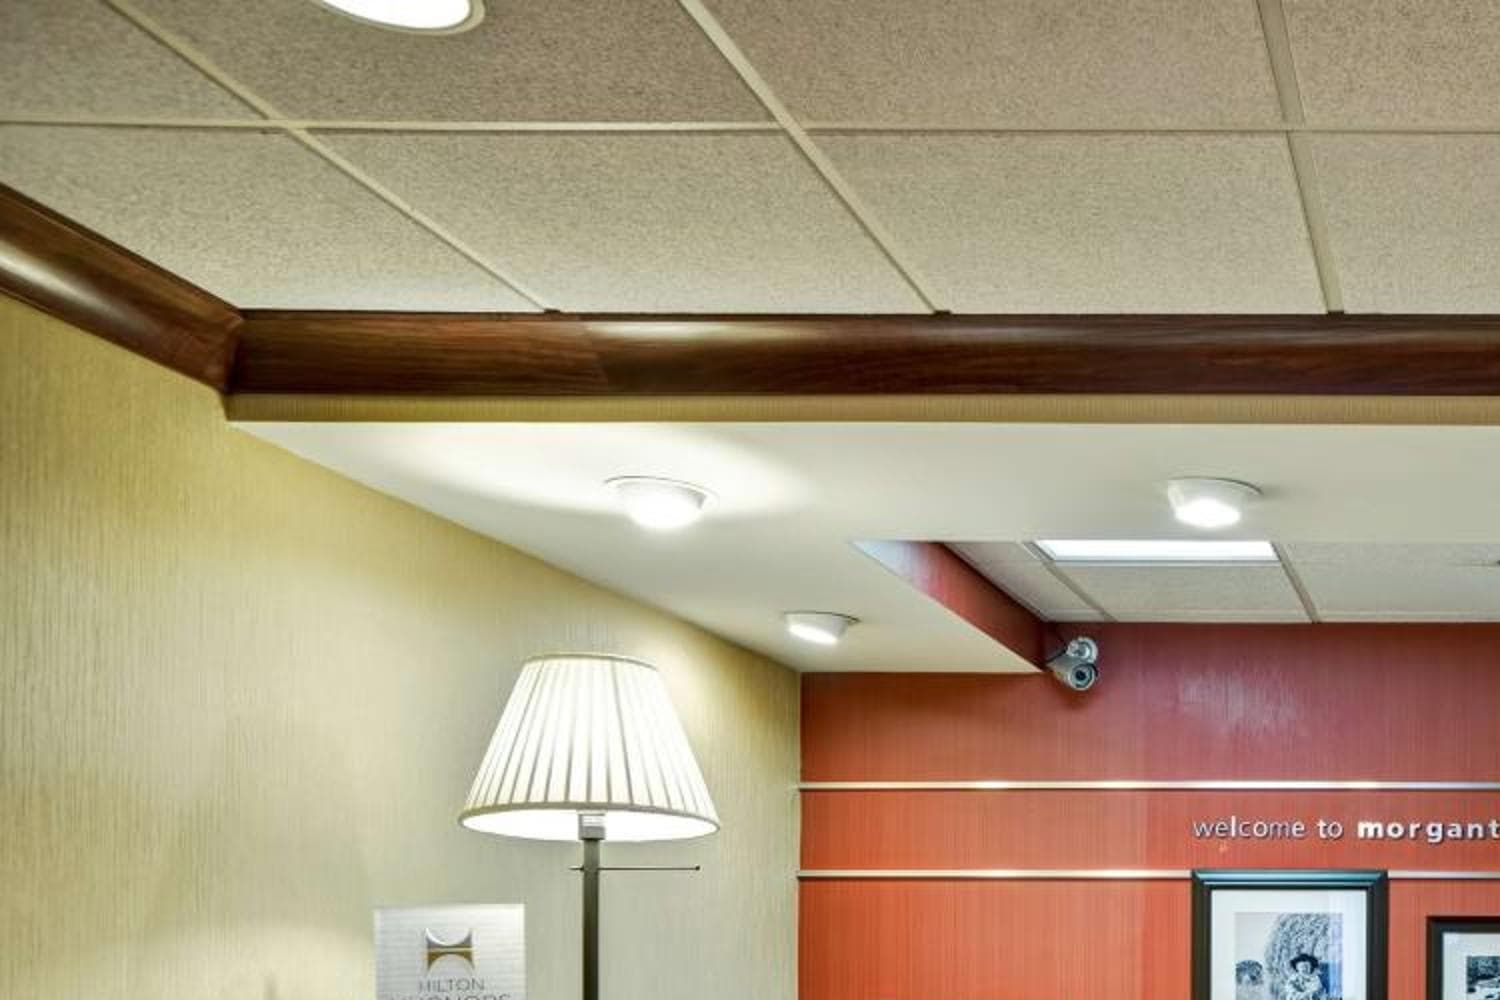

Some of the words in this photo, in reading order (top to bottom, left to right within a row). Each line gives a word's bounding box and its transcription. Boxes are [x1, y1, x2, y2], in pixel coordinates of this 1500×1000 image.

[1194, 815, 1305, 838] welcome
[1317, 819, 1344, 839] to
[419, 977, 486, 993] HILTON
